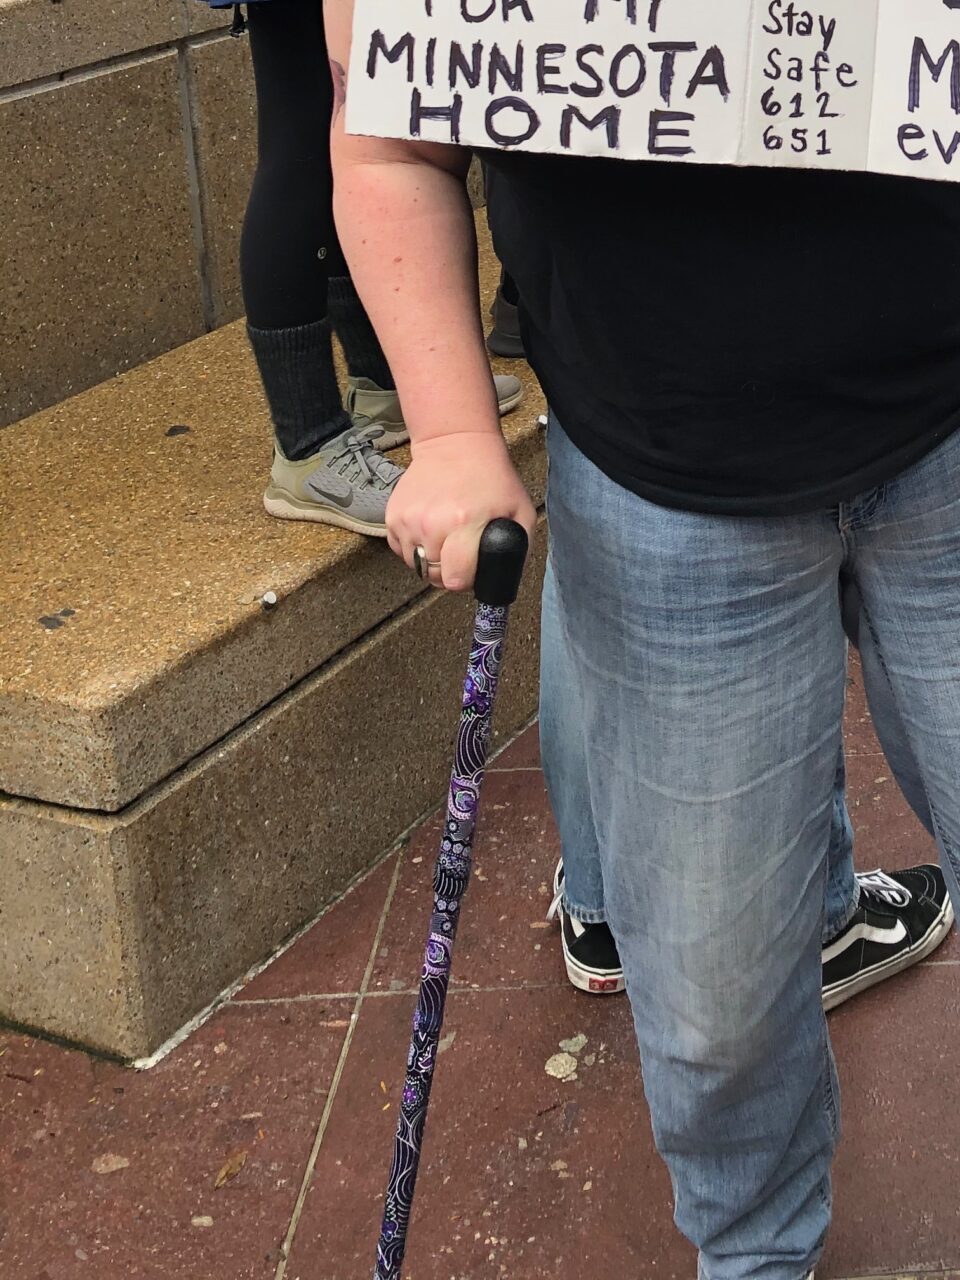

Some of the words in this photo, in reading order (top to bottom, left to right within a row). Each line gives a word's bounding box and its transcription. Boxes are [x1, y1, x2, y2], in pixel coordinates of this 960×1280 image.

[366, 29, 732, 107] MINNESOTA
[763, 48, 858, 92] Safe
[409, 87, 696, 156] HOME
[760, 86, 842, 118] 612
[762, 125, 831, 155] 651
